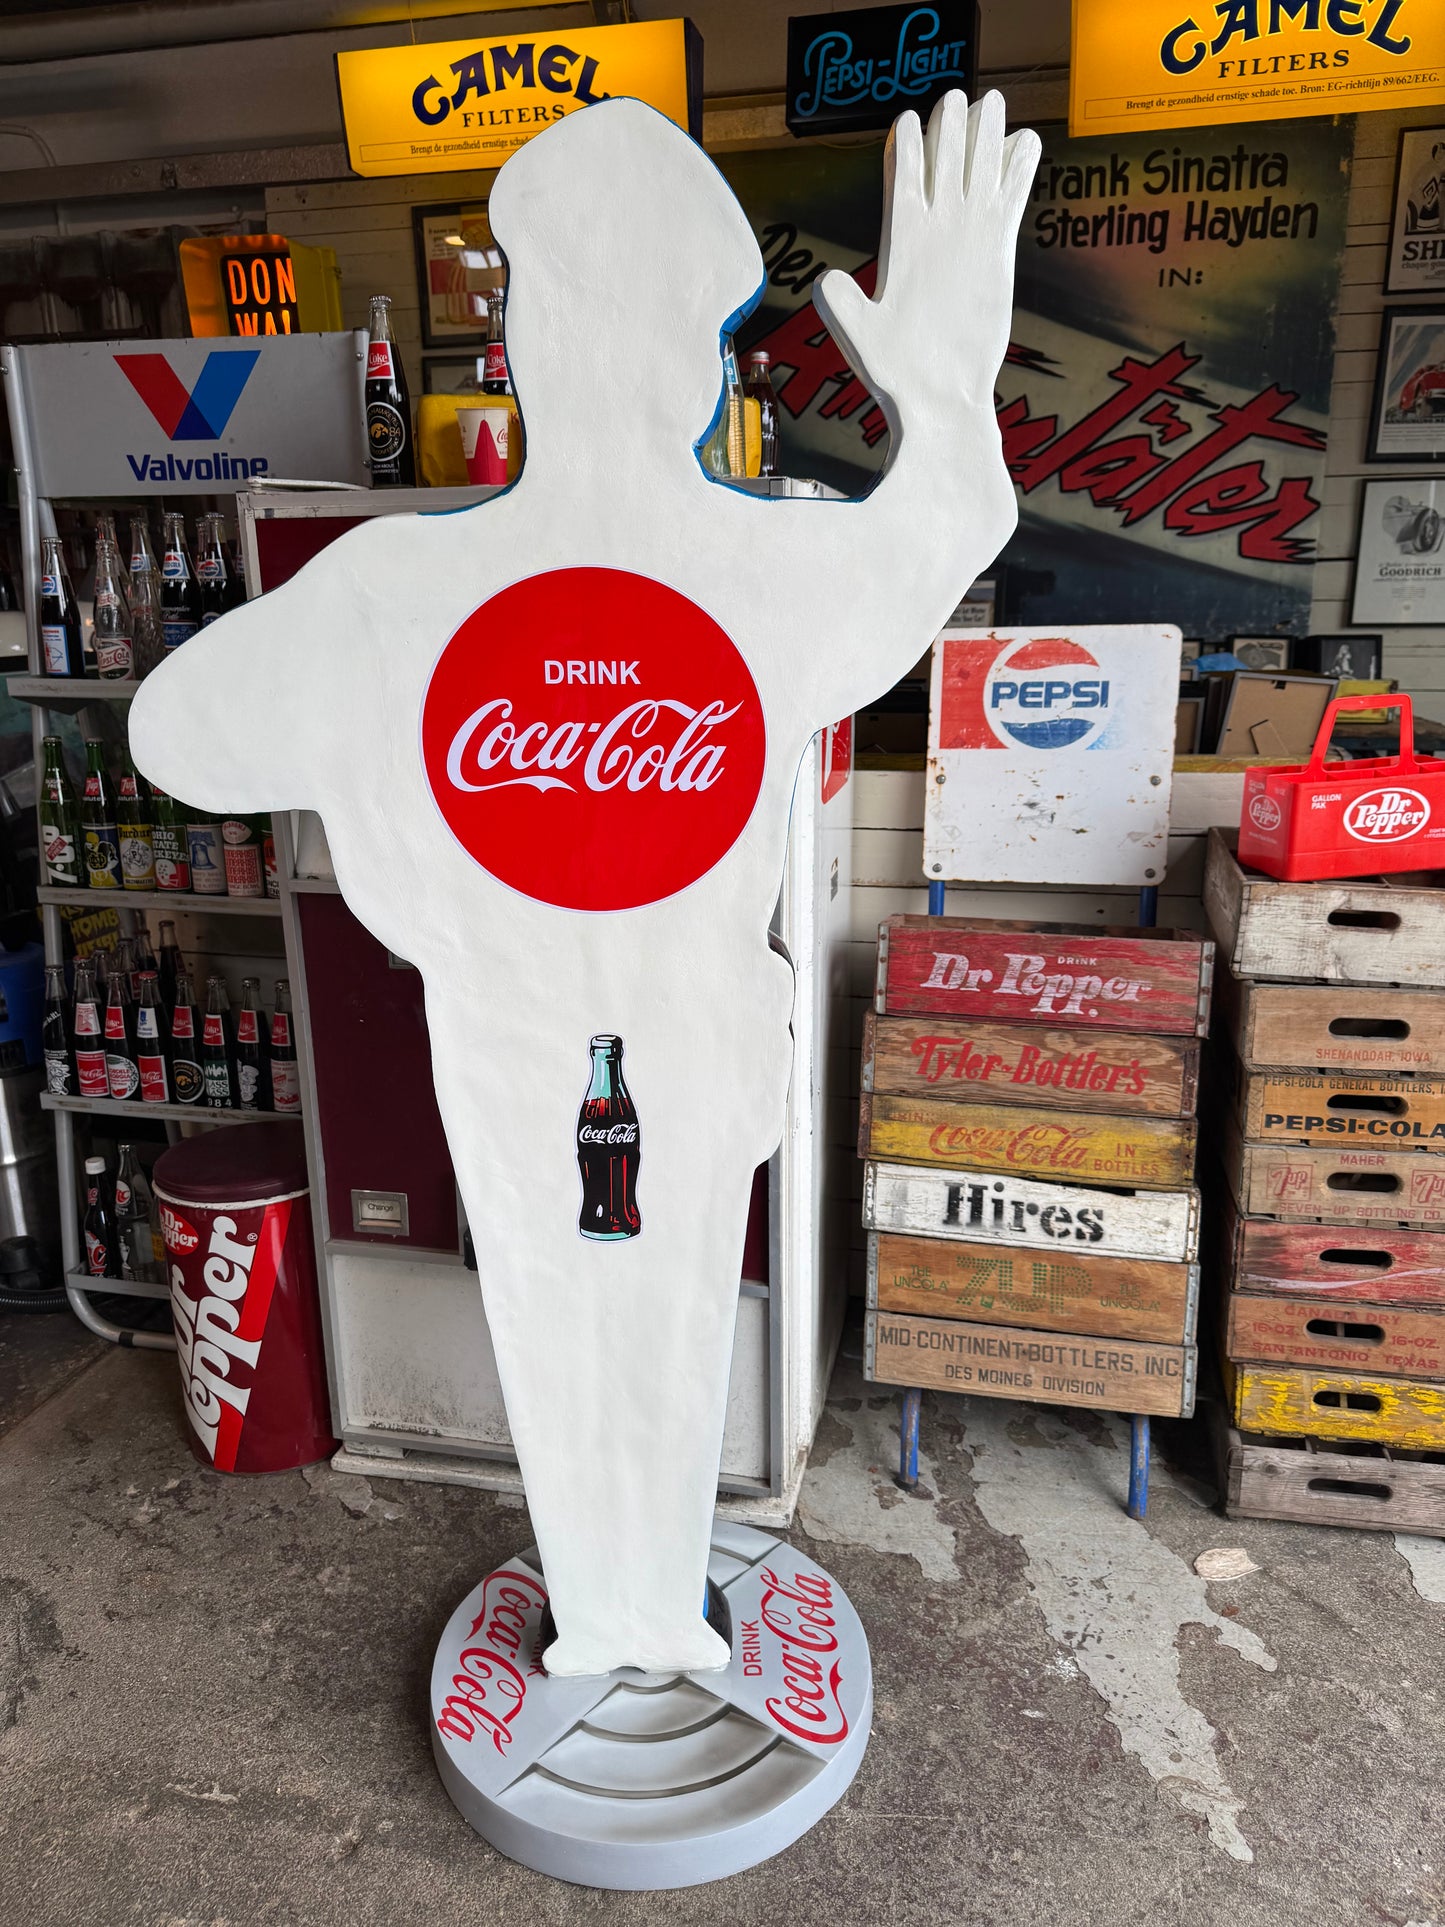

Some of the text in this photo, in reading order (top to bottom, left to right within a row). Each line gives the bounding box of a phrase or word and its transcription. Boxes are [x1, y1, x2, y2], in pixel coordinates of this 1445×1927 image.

[1160, 0, 1413, 76] CAMEL
[1217, 49, 1350, 79] FILTERS
[412, 43, 610, 126] CAMEL
[1126, 99, 1154, 110] Brengt
[1155, 98, 1166, 107] de
[1167, 94, 1214, 107] gezondheid
[1216, 92, 1250, 102] ernstige
[1251, 87, 1280, 98] schade
[1282, 87, 1298, 96] toe.
[1300, 84, 1326, 94] Bron:
[1382, 72, 1440, 87] 89/662/EEG.
[462, 104, 566, 128] FILTERS
[1033, 144, 1289, 202] Frank Sinatra
[1034, 196, 1319, 254] Sterling Hayden
[1158, 267, 1204, 288] IN:
[369, 353, 388, 364] Coke
[126, 451, 268, 481] Valvoline
[544, 659, 642, 685] DRINK
[991, 680, 1110, 708] PEPSI
[447, 698, 745, 794] Coca-Cola
[1312, 794, 1342, 802] GALLON
[1377, 793, 1412, 814] Dr
[1352, 804, 1424, 835] Pepper
[1057, 956, 1098, 966] DRINK
[920, 952, 1153, 1014] Dr Pepper
[911, 1035, 1149, 1095] Tyler-Bottler's
[1400, 1051, 1431, 1062] IOWA
[1264, 1075, 1324, 1089] PEPSI-COLA
[1329, 1077, 1375, 1091] GENERAL
[1379, 1080, 1435, 1095] BOTTLERS,
[579, 1123, 639, 1146] Coca-Cola
[929, 1122, 1095, 1169] Coca-Cola
[1116, 1142, 1136, 1158] IN
[1339, 1155, 1385, 1166] MAHER
[1093, 1158, 1160, 1176] BOTTLES
[163, 1208, 184, 1233] Dr
[942, 1181, 1105, 1243] Hires
[1356, 1205, 1416, 1219] BOTTLING
[893, 1275, 949, 1291] UNCOLA
[910, 1264, 932, 1277] THE
[956, 1256, 1094, 1315] 7UP
[1100, 1295, 1161, 1312] UNCOLA
[1284, 1305, 1401, 1325] CANADA DRY
[1252, 1342, 1440, 1370] SAN ANTONIO TEXAS
[945, 1364, 1106, 1397] DES MOINES DIVISION
[742, 1618, 764, 1678] DRINK
[761, 1564, 848, 1745] Coca-Cola
[437, 1569, 552, 1759] Coca-Cola
